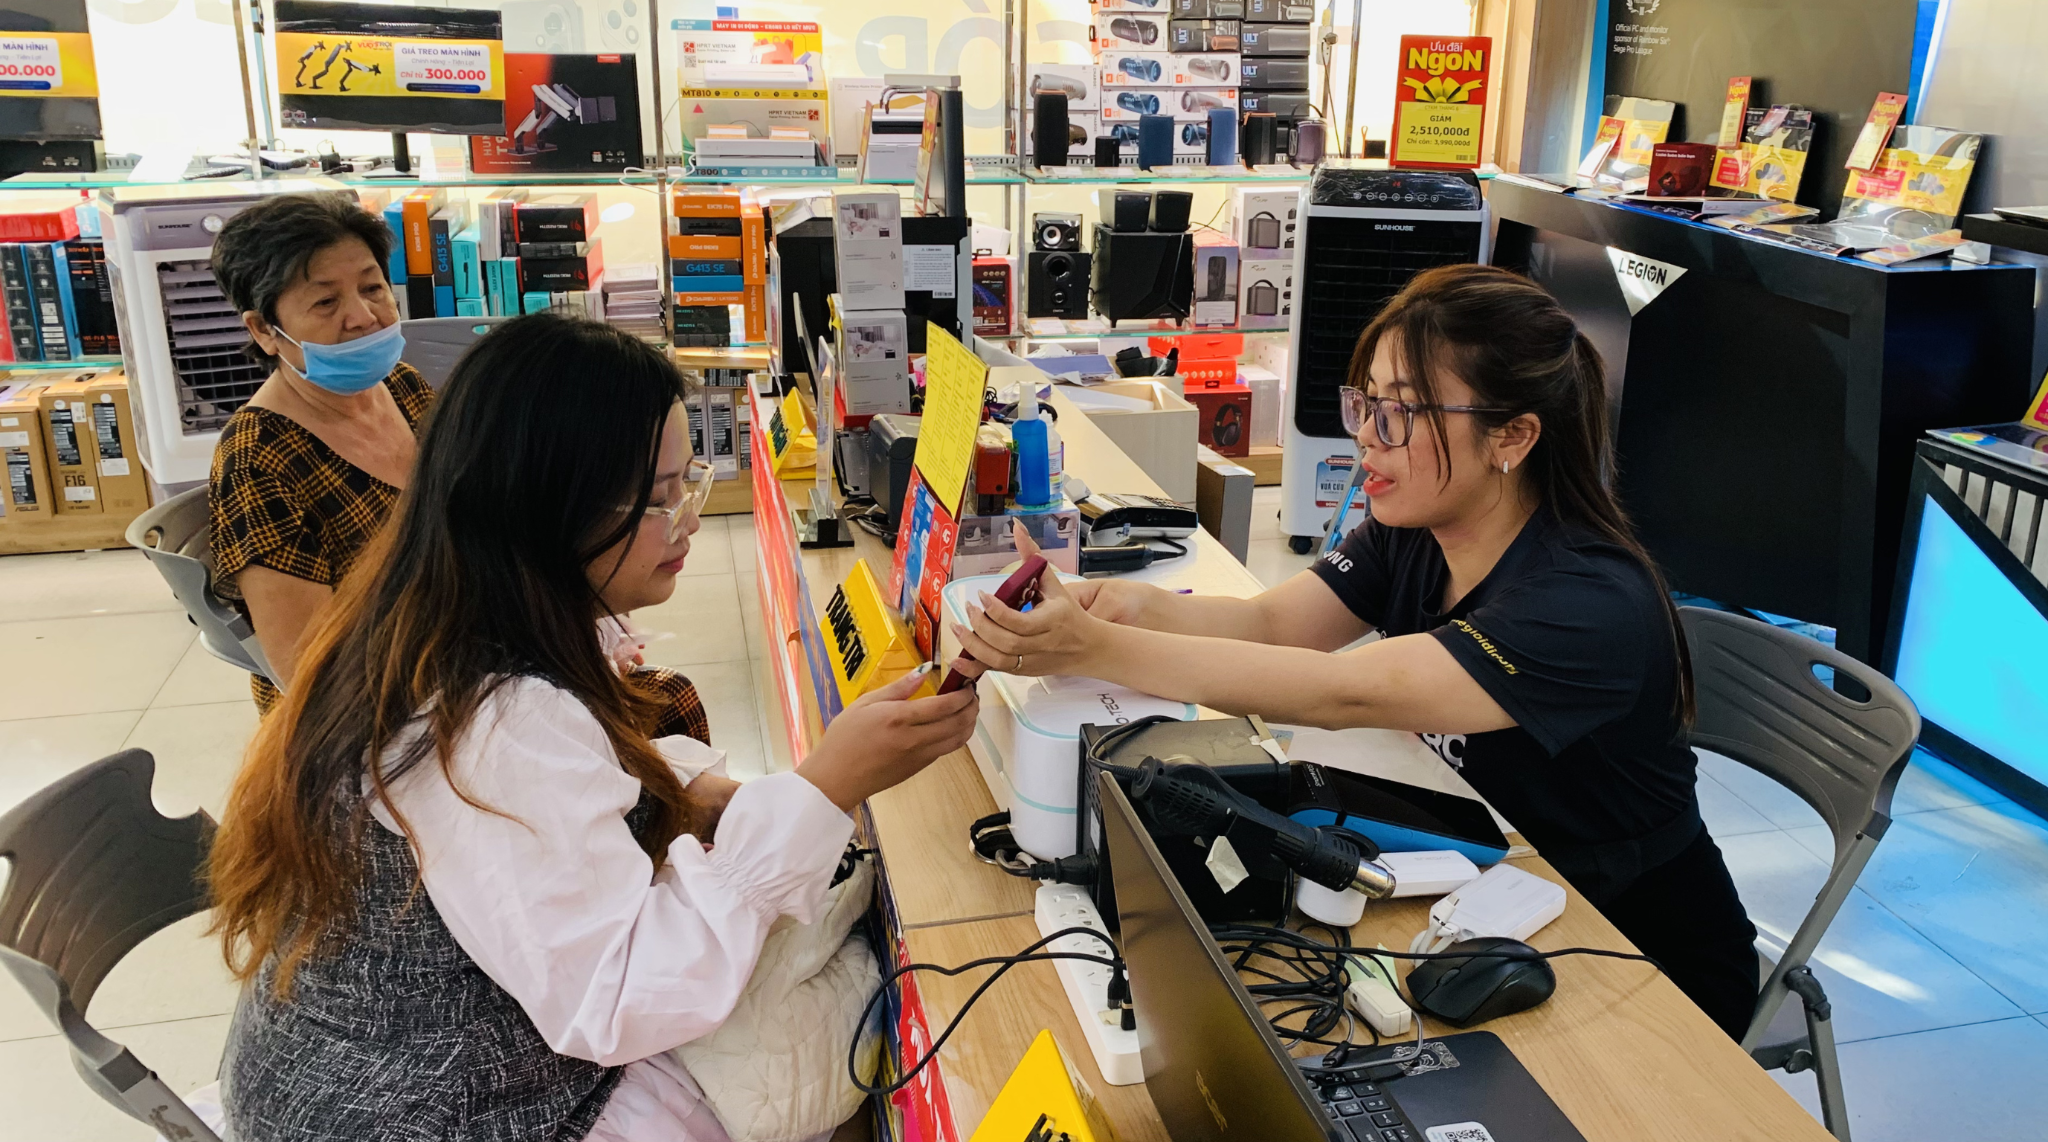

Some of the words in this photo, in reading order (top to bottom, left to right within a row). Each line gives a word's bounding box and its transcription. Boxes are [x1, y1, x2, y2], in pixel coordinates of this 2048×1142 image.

[1616, 24, 1631, 32] Official
[1640, 25, 1649, 33] and
[1650, 26, 1669, 34] monitor
[1179, 28, 1187, 44] ULT
[1243, 33, 1259, 43] ULT
[3, 42, 24, 51] MÀN
[25, 41, 48, 51] HÌNH
[1430, 41, 1445, 52] Ưu
[1447, 42, 1463, 52] đãi
[1635, 46, 1653, 56] League
[402, 47, 416, 55] GIÁ
[441, 47, 459, 56] MÀN
[461, 48, 481, 57] HÌNH
[1408, 48, 1483, 76] NgoN
[425, 68, 486, 81] 300.000
[1242, 66, 1258, 76] ULT
[682, 90, 711, 98] MT810
[1243, 99, 1258, 109] ULT
[1874, 102, 1903, 115] NgoN
[1430, 114, 1452, 122] GIẢM
[1410, 126, 1470, 137] 2,510,000đ
[1434, 139, 1471, 147] 3,990,000đ
[1374, 224, 1414, 232] SUNHOUSE
[436, 233, 447, 245] SE
[436, 247, 449, 273] G413
[686, 264, 711, 273] G413
[713, 264, 725, 273] SE
[1618, 257, 1667, 286] LEGION
[65, 475, 86, 487] F16
[942, 528, 951, 544] 4G
[933, 576, 941, 593] 4G
